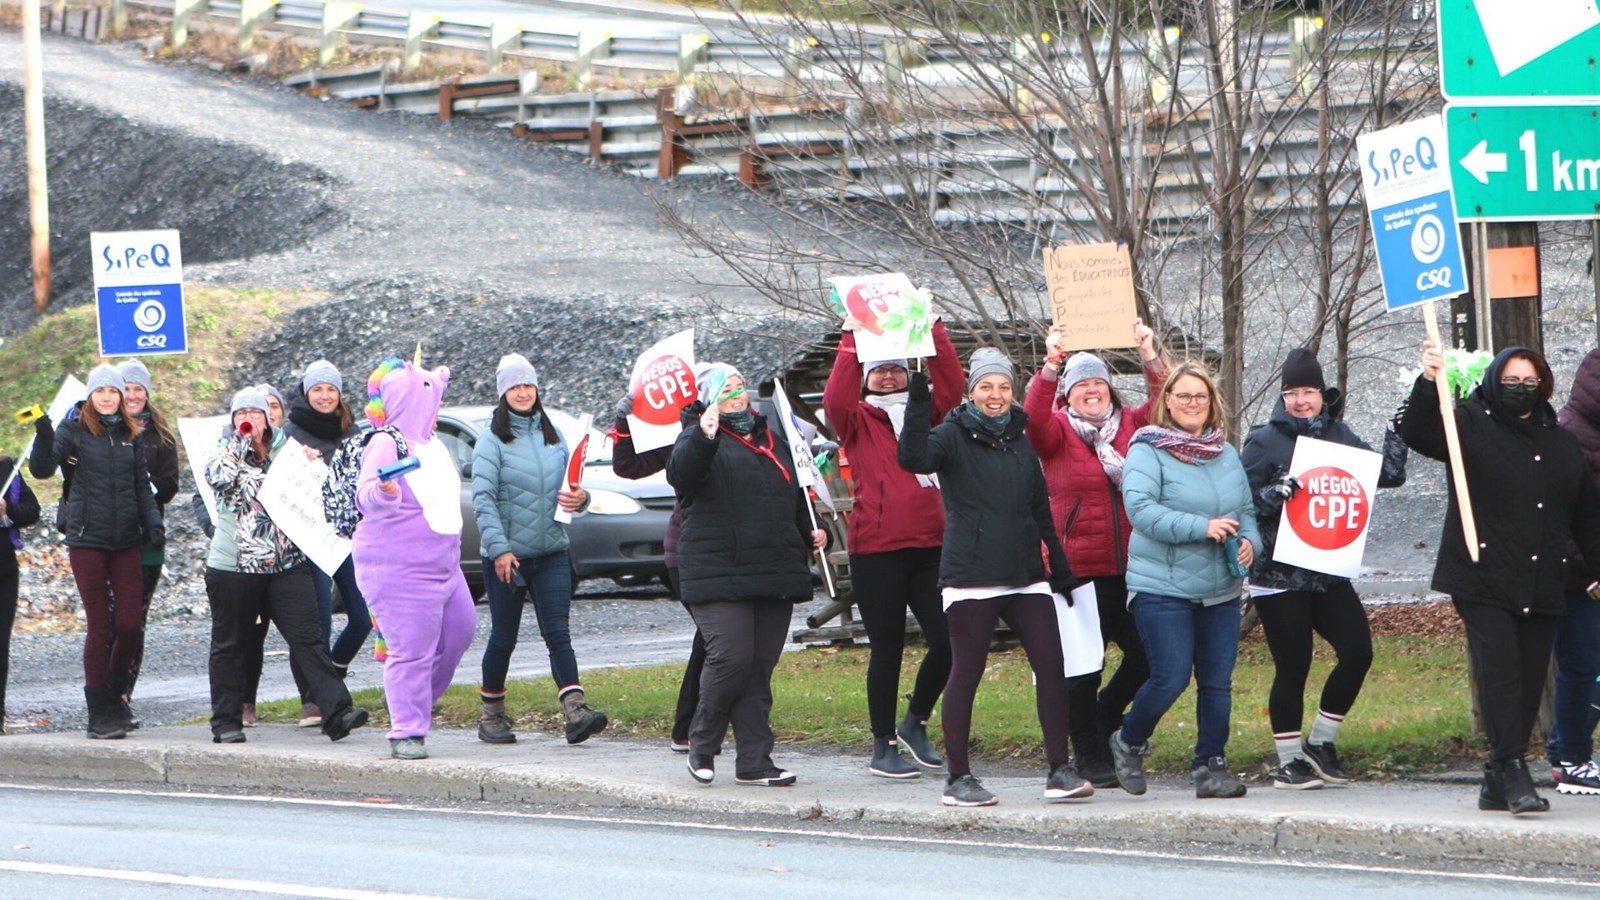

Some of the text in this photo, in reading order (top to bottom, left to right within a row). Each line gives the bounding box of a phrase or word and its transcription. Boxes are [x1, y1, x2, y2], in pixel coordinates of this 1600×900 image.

[1519, 129, 1600, 192] 1 km
[1416, 266, 1452, 291] CSQ
[136, 334, 167, 349] CSQ
[643, 370, 692, 410] CPE
[1308, 472, 1360, 496] NÉGOS
[1308, 496, 1361, 529] CPE
